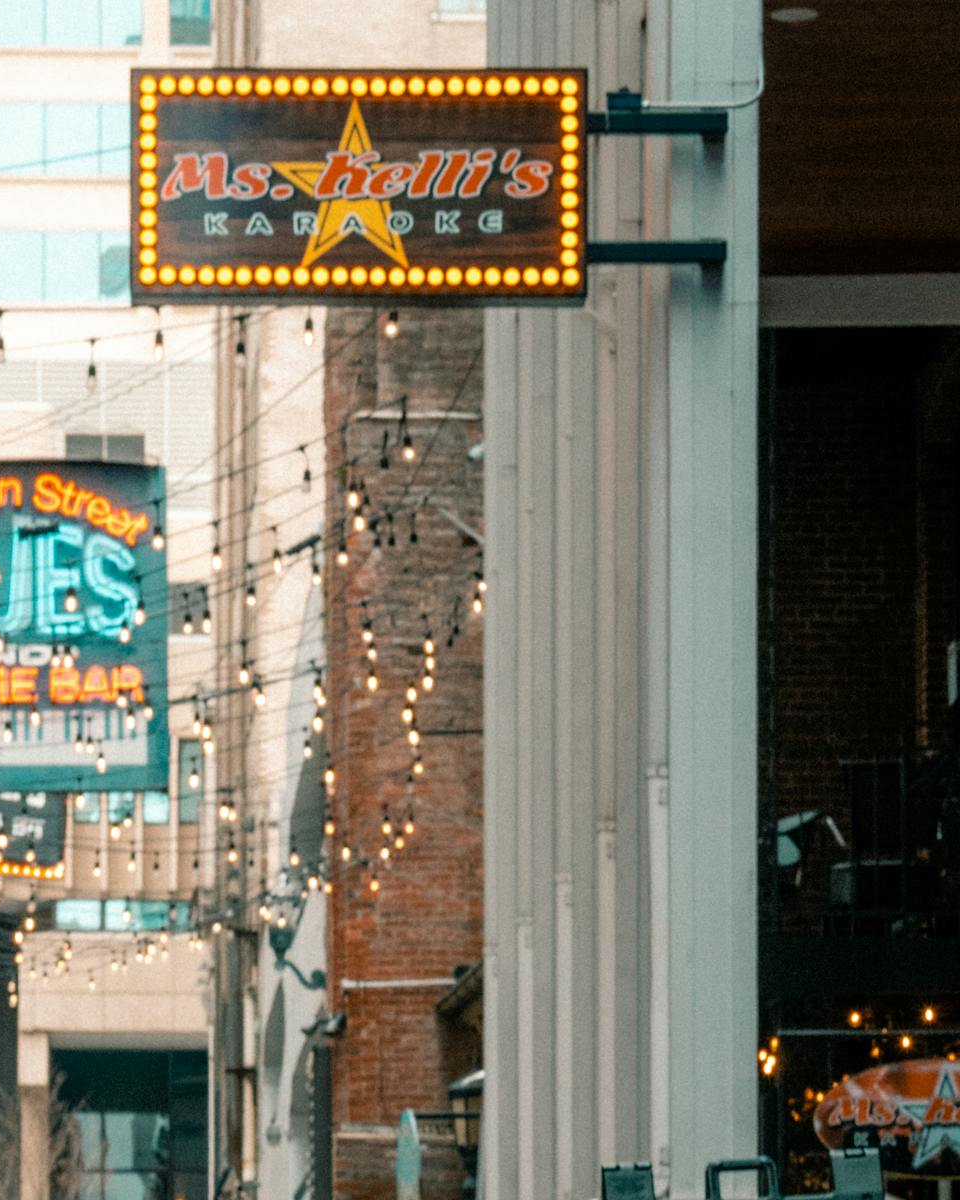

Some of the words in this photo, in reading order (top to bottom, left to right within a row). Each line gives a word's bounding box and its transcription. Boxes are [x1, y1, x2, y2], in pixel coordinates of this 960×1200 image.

[161, 151, 295, 200] Ms.
[314, 148, 554, 200] Kelli's
[203, 209, 504, 236] KARAOKE
[33, 470, 150, 546] Street
[47, 664, 144, 704] BAR
